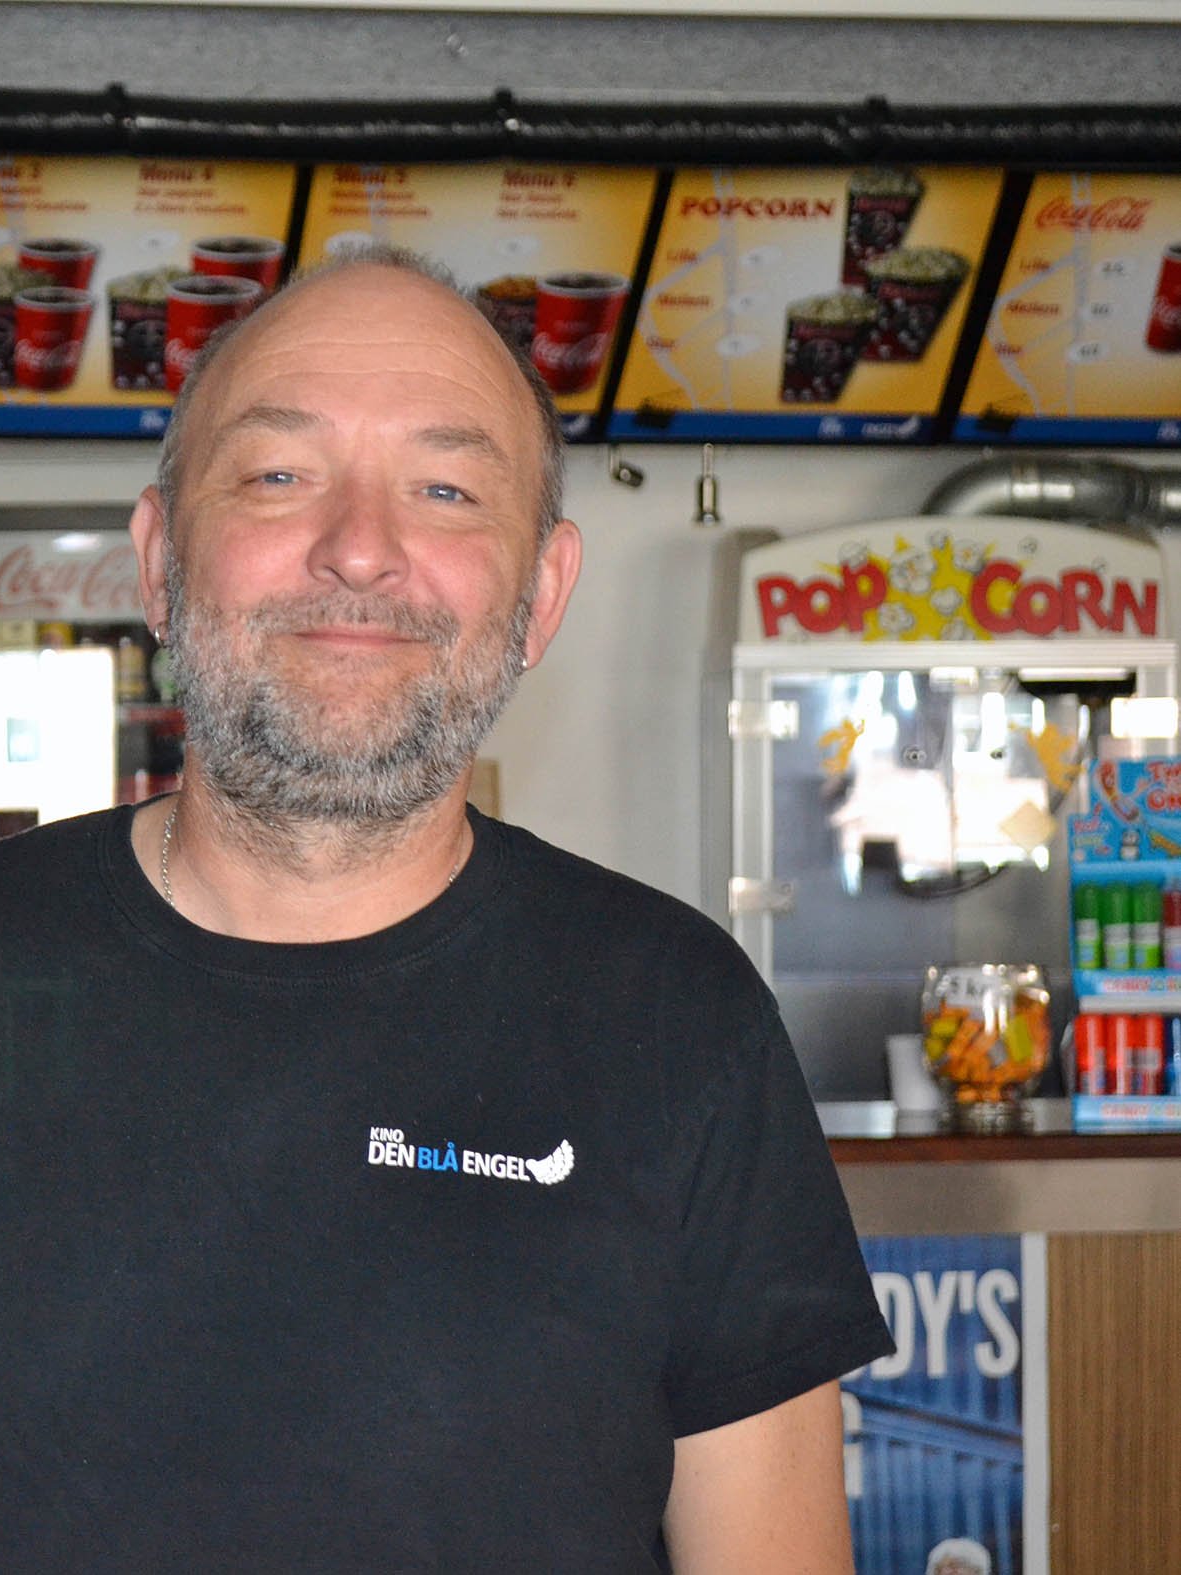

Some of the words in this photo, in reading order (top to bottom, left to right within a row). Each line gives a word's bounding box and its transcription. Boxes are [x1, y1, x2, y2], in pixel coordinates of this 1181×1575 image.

[680, 197, 836, 219] POPCORN
[757, 559, 888, 638] POP
[970, 557, 1158, 637] CORN
[368, 1141, 415, 1168] DEN
[418, 1141, 459, 1172] BLÅ
[462, 1149, 530, 1181] ENGEL
[370, 1126, 404, 1143] KINO
[839, 1268, 1020, 1381] DY'S
